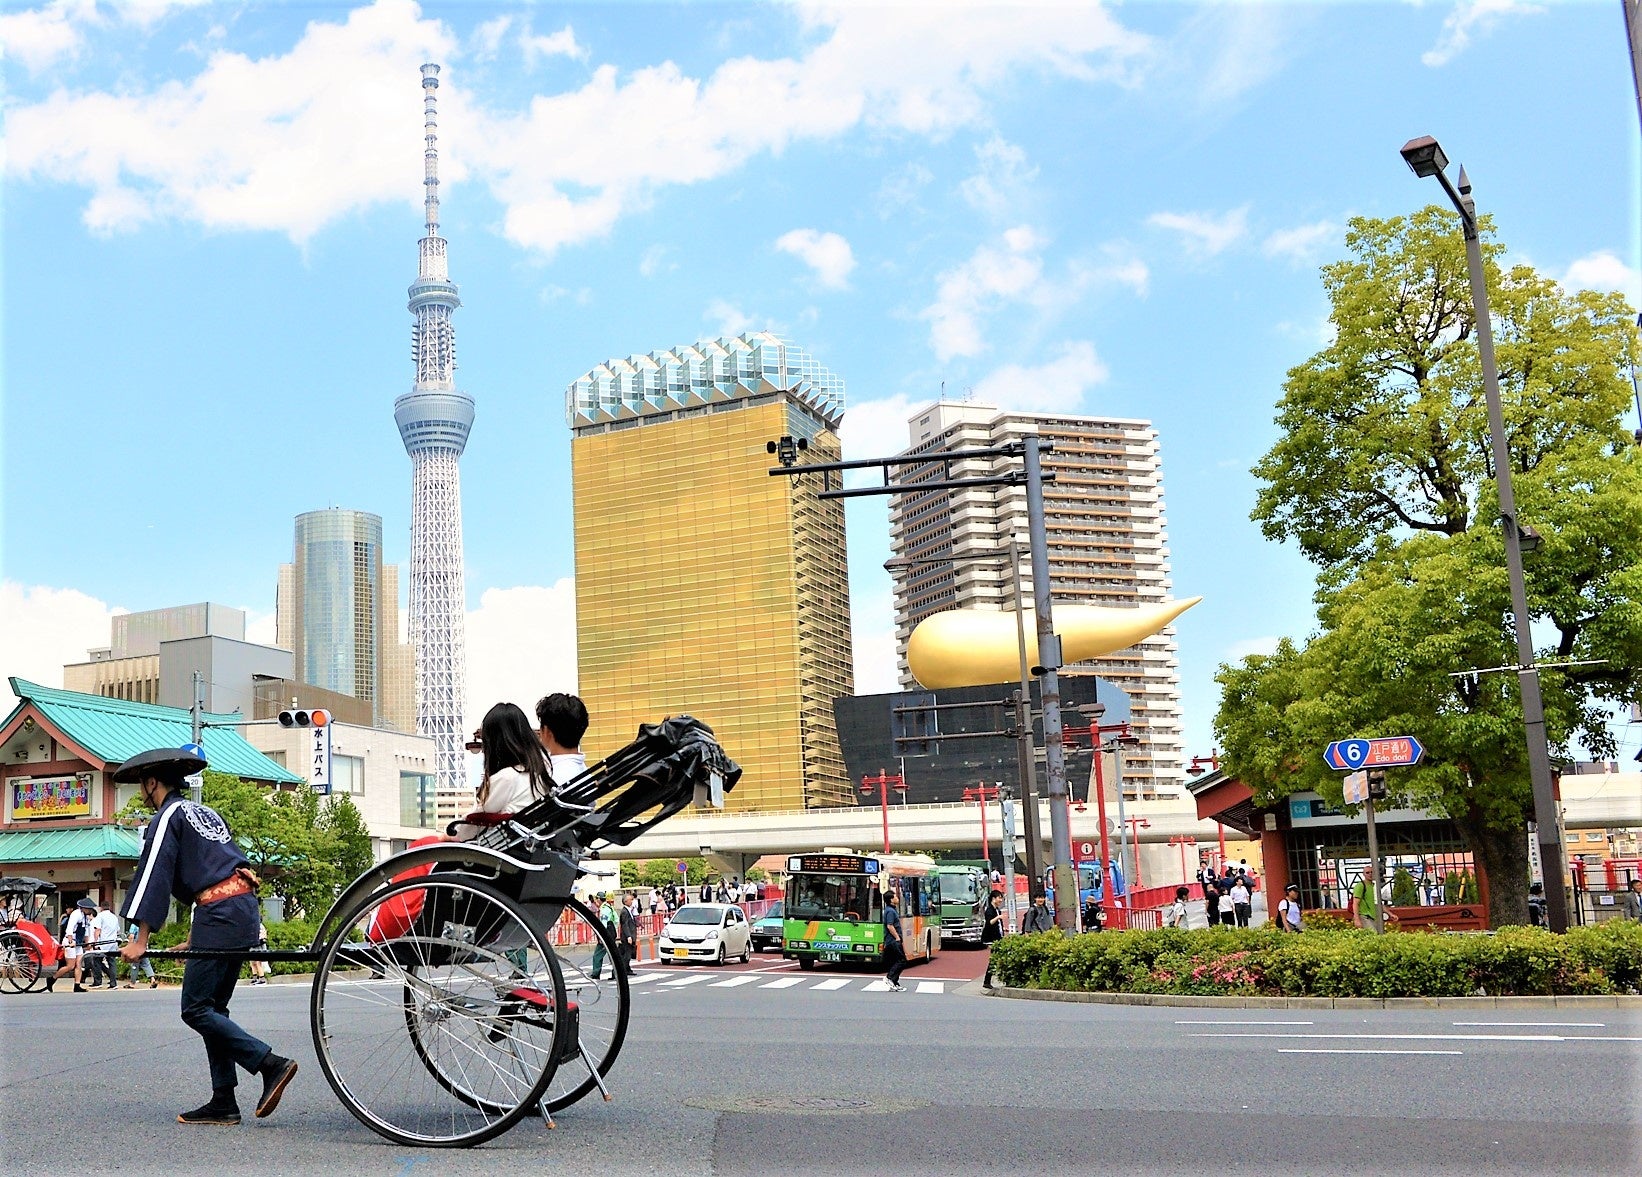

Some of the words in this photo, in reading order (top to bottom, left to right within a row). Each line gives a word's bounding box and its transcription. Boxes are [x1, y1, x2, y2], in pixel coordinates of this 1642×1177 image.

[314, 728, 323, 777] 水上バス
[1347, 743, 1361, 761] 6
[1372, 741, 1408, 755] 江戸通り
[1393, 753, 1407, 761] dori
[190, 778, 199, 786] 20
[814, 942, 849, 950] ノンステップバス
